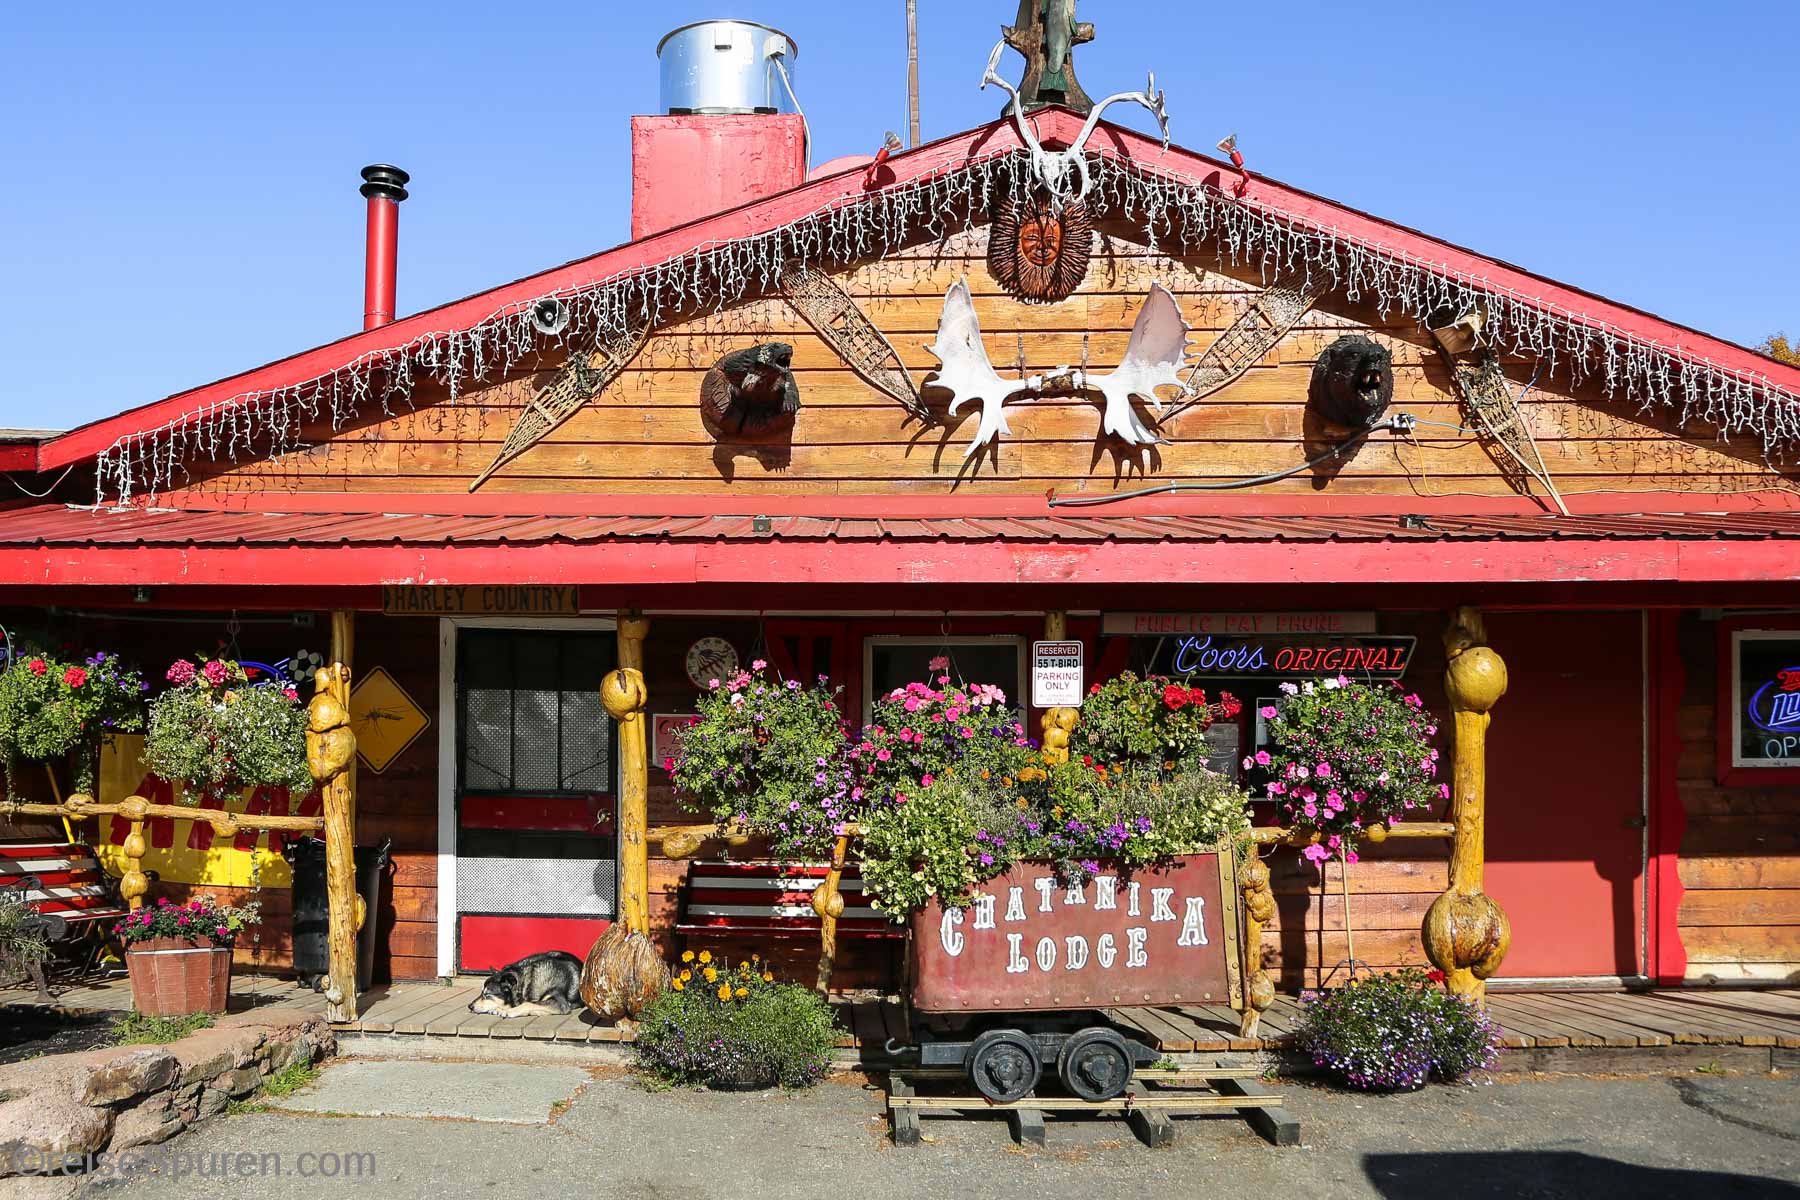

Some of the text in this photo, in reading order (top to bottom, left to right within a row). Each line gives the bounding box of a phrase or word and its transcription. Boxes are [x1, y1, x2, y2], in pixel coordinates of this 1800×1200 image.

[394, 586, 567, 611] HARLEY COUNTRY
[1135, 615, 1344, 632] PUBLIC PAY PHONE
[1039, 647, 1077, 655] RESERVED
[1275, 648, 1406, 671] ORIGINAL
[1038, 658, 1078, 668] 55 T-BIRD
[1037, 672, 1079, 681] PARKING
[1045, 681, 1070, 690] ONLY
[1765, 736, 1800, 759] OP
[940, 876, 1209, 957] CHATANIKA
[1006, 927, 1148, 974] LODGE
